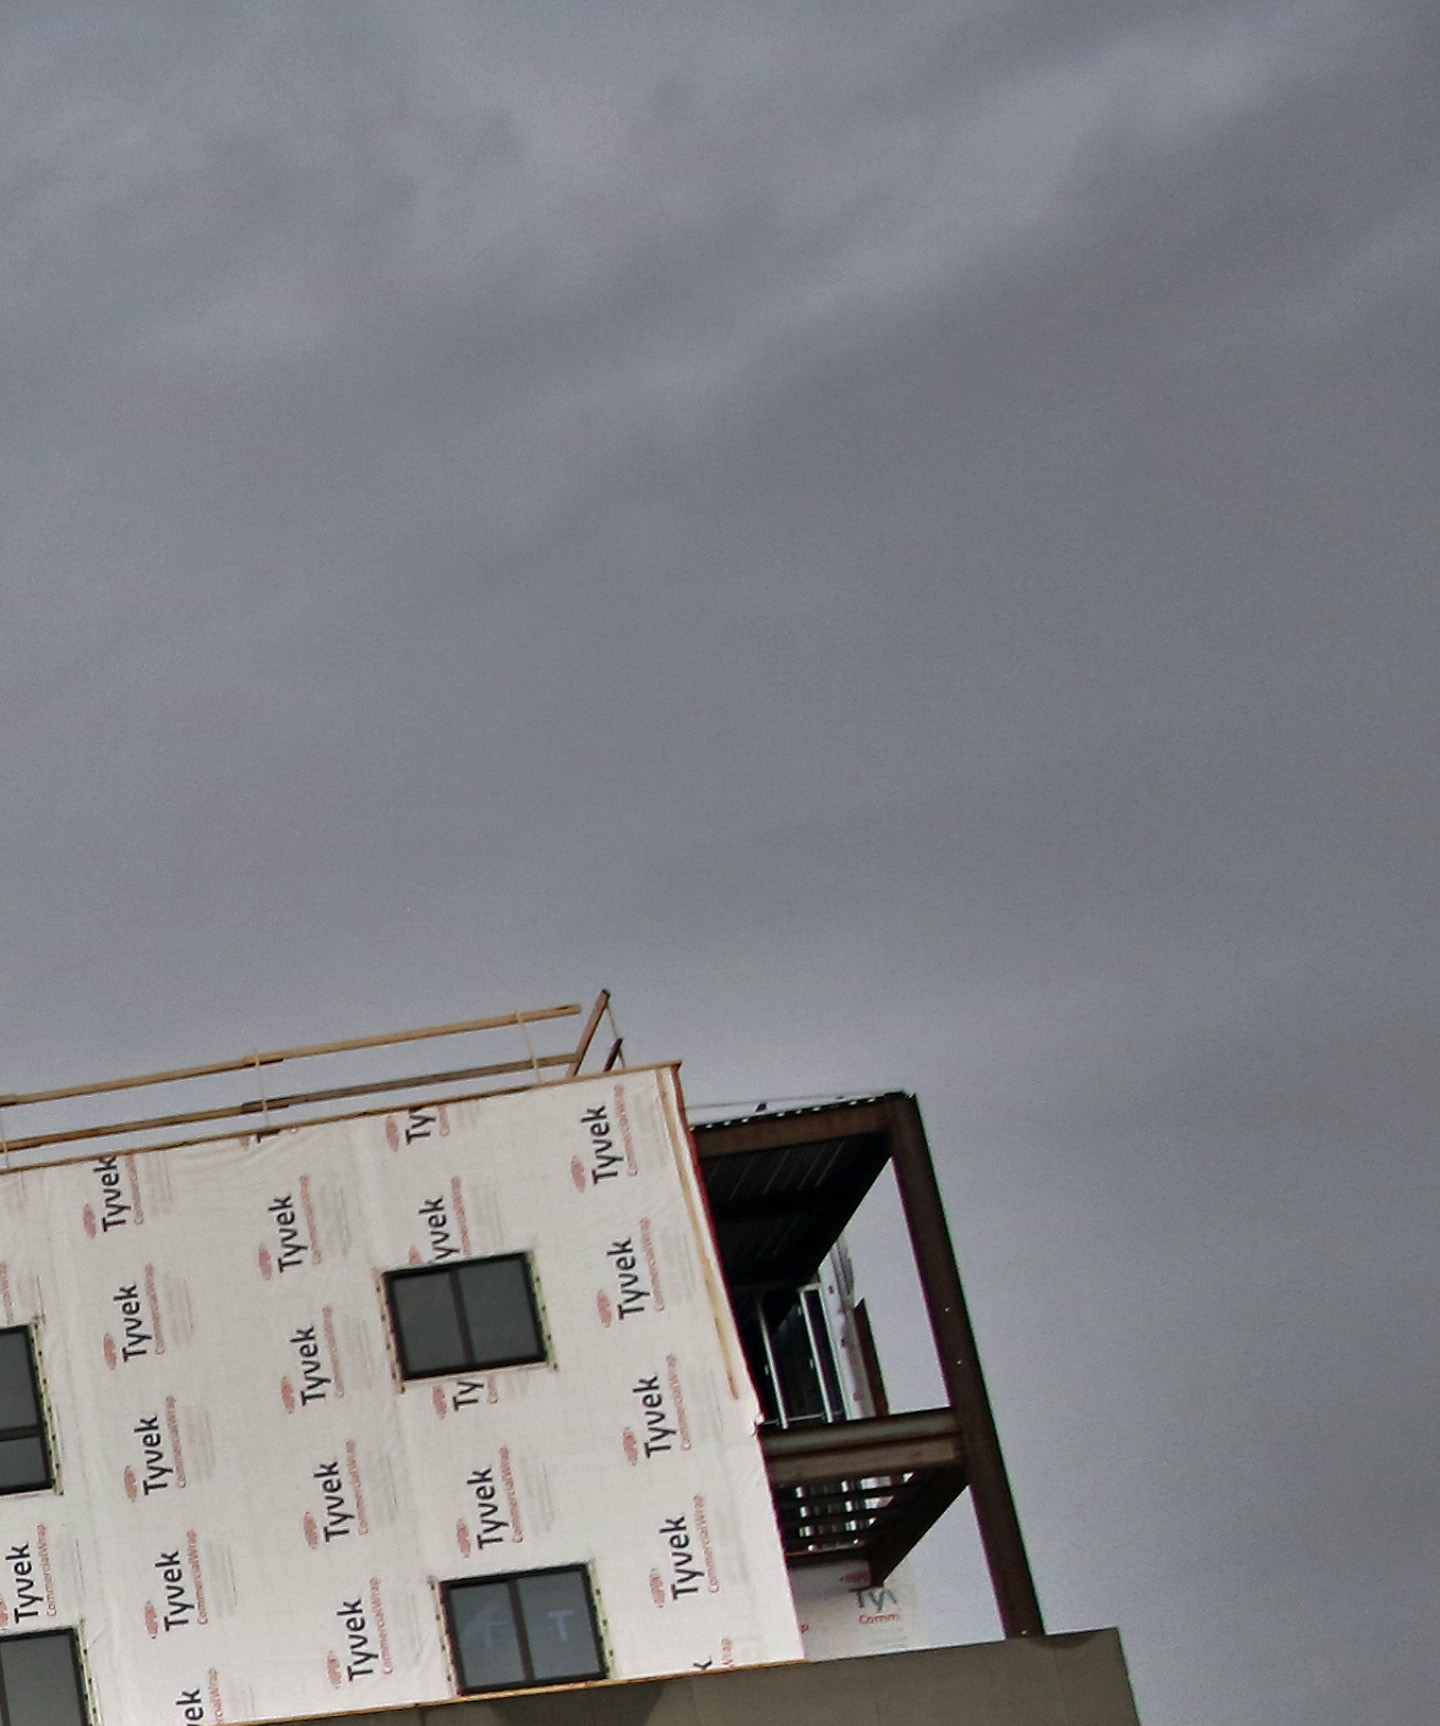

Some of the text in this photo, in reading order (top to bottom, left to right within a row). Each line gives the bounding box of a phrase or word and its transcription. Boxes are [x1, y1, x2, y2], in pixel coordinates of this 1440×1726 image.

[581, 1106, 624, 1185] Tyvek
[94, 1156, 130, 1232] Tyvek
[418, 1197, 460, 1263] yvek
[268, 1196, 308, 1273] Tyvek
[607, 1239, 650, 1320] Tyvek
[114, 1284, 152, 1362] Tyvek
[290, 1326, 331, 1406] Tyvek
[134, 1416, 173, 1496] Tyvek
[632, 1376, 677, 1459] Tyvek
[314, 1462, 355, 1542] Tyvek
[466, 1468, 509, 1549] Tyvek
[5, 1544, 44, 1623] Tyvek
[155, 1551, 194, 1631] Tyvek
[660, 1516, 704, 1601] Tyvek
[337, 1600, 378, 1680] Tyvek
